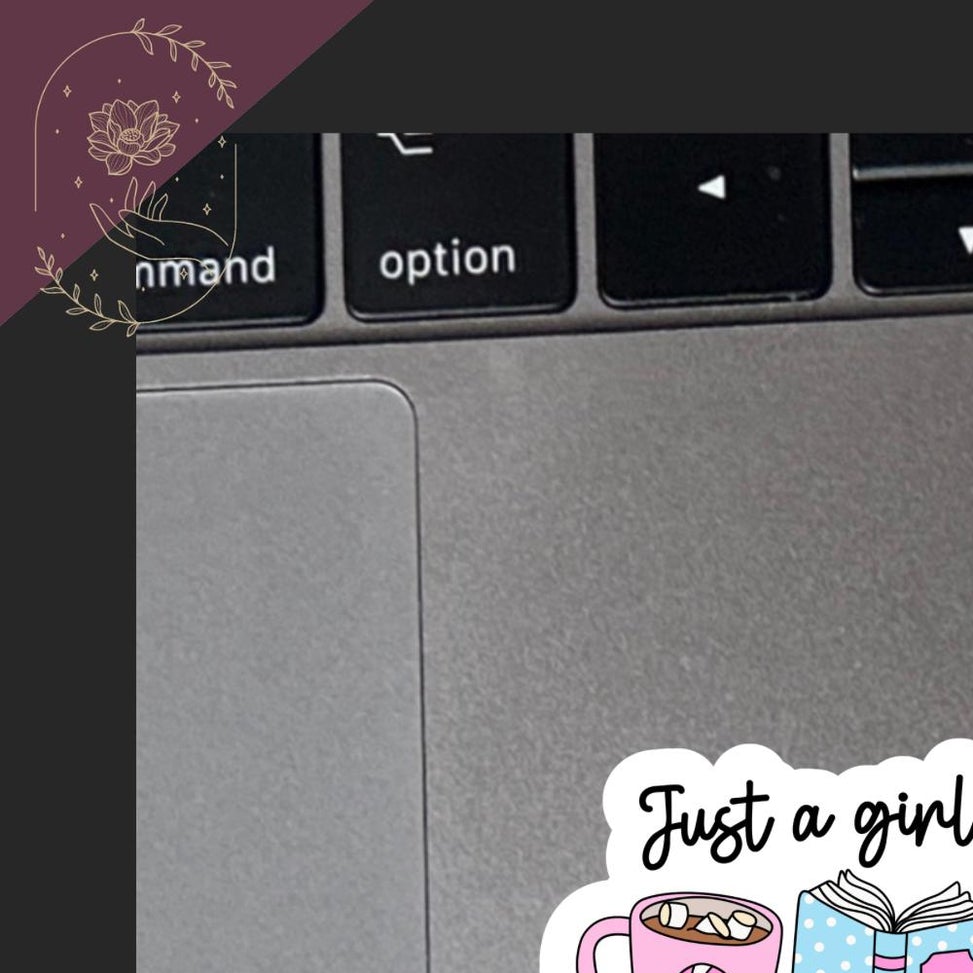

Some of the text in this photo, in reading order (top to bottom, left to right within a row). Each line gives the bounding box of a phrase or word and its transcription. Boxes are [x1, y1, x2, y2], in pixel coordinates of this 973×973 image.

[379, 238, 516, 286] option
[639, 780, 775, 870] Just
[792, 804, 835, 842] a
